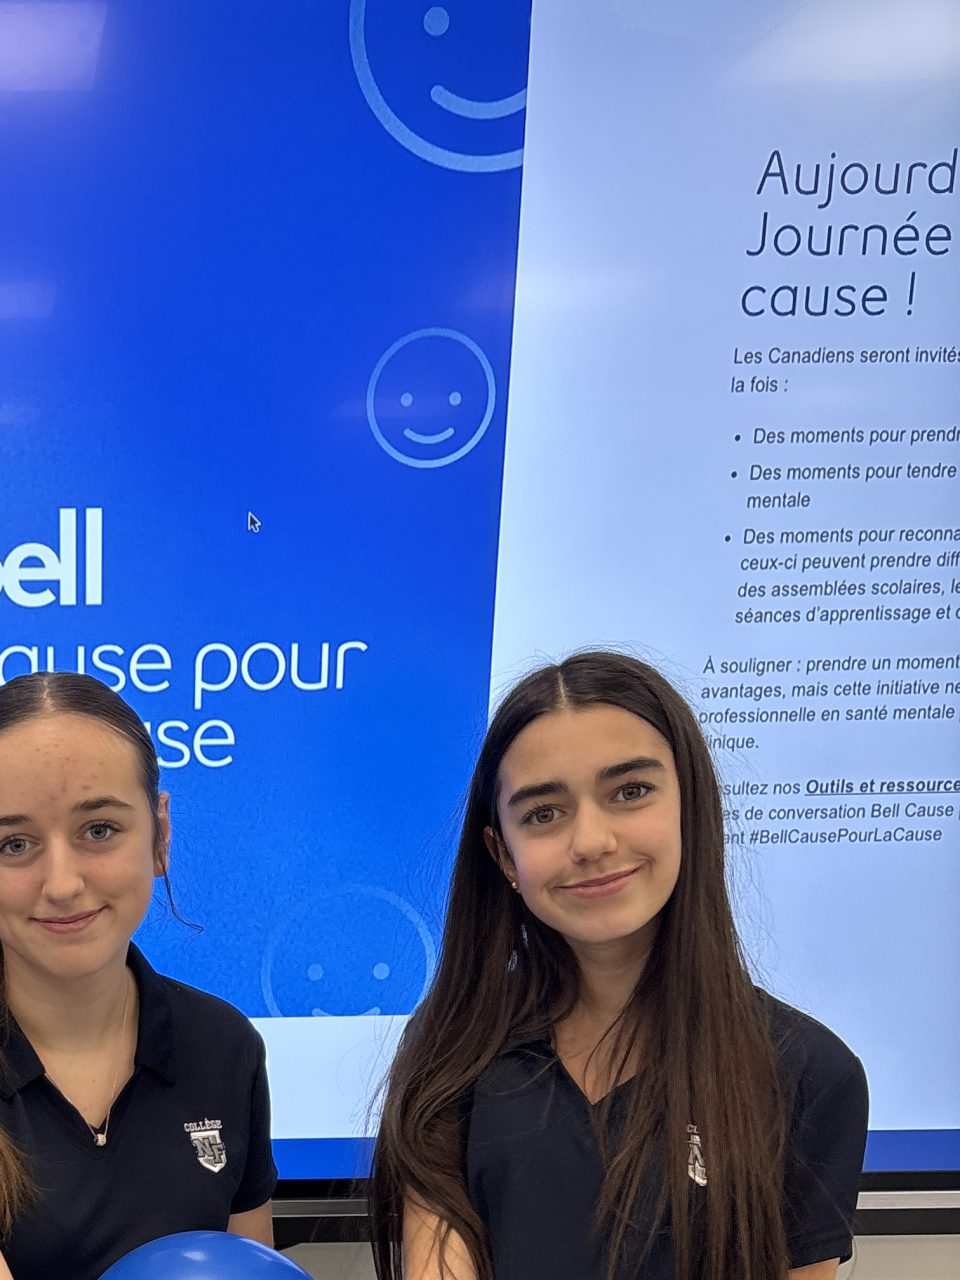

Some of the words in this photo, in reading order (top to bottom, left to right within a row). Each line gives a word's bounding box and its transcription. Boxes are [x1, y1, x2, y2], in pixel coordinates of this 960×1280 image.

[756, 147, 959, 209] Aujourd
[746, 211, 952, 256] Journée
[741, 284, 888, 317] cause
[906, 271, 916, 316] !
[733, 347, 763, 364] Les
[768, 346, 855, 364] Canadiens
[859, 347, 910, 363] seront
[730, 376, 745, 393] la
[750, 375, 778, 393] fois
[783, 378, 789, 392] :
[753, 427, 786, 444] Des
[790, 426, 864, 444] moments
[869, 428, 907, 446] pour
[749, 464, 782, 481] Des
[786, 463, 861, 480] moments
[865, 465, 903, 482] pour
[906, 462, 957, 479] tendre
[746, 491, 811, 509] mentale
[743, 528, 775, 545] Des
[779, 527, 853, 544] moments
[858, 529, 895, 546] pour
[740, 553, 798, 571] ceux-ci
[801, 552, 866, 573] peuvent
[869, 552, 931, 572] prendre
[737, 582, 766, 598] des
[771, 579, 866, 597] assemblées
[871, 578, 945, 597] scolaires,
[735, 606, 801, 624] séances
[805, 605, 931, 625] d'apprentissage
[935, 604, 951, 620] et
[194, 639, 369, 710] pour
[703, 655, 715, 674] À
[720, 656, 792, 676] souligner
[805, 655, 867, 675] prendre
[872, 657, 891, 670] un
[896, 653, 960, 670] moment
[701, 682, 787, 702] avantages,
[791, 680, 829, 698] mais
[833, 680, 872, 697] cette
[876, 679, 940, 695] initiative
[820, 709, 840, 721] en
[845, 704, 888, 721] santé
[893, 703, 955, 720] mentale
[723, 780, 769, 796] sultez
[773, 781, 801, 795] nos
[805, 778, 854, 795] Outils
[859, 779, 875, 793] et
[879, 779, 960, 793] ressource
[744, 805, 764, 821] de
[768, 804, 866, 821] conversation
[871, 803, 900, 819] Bell
[904, 802, 954, 818] Cause
[749, 827, 943, 845] #BellCausePourLaCause
